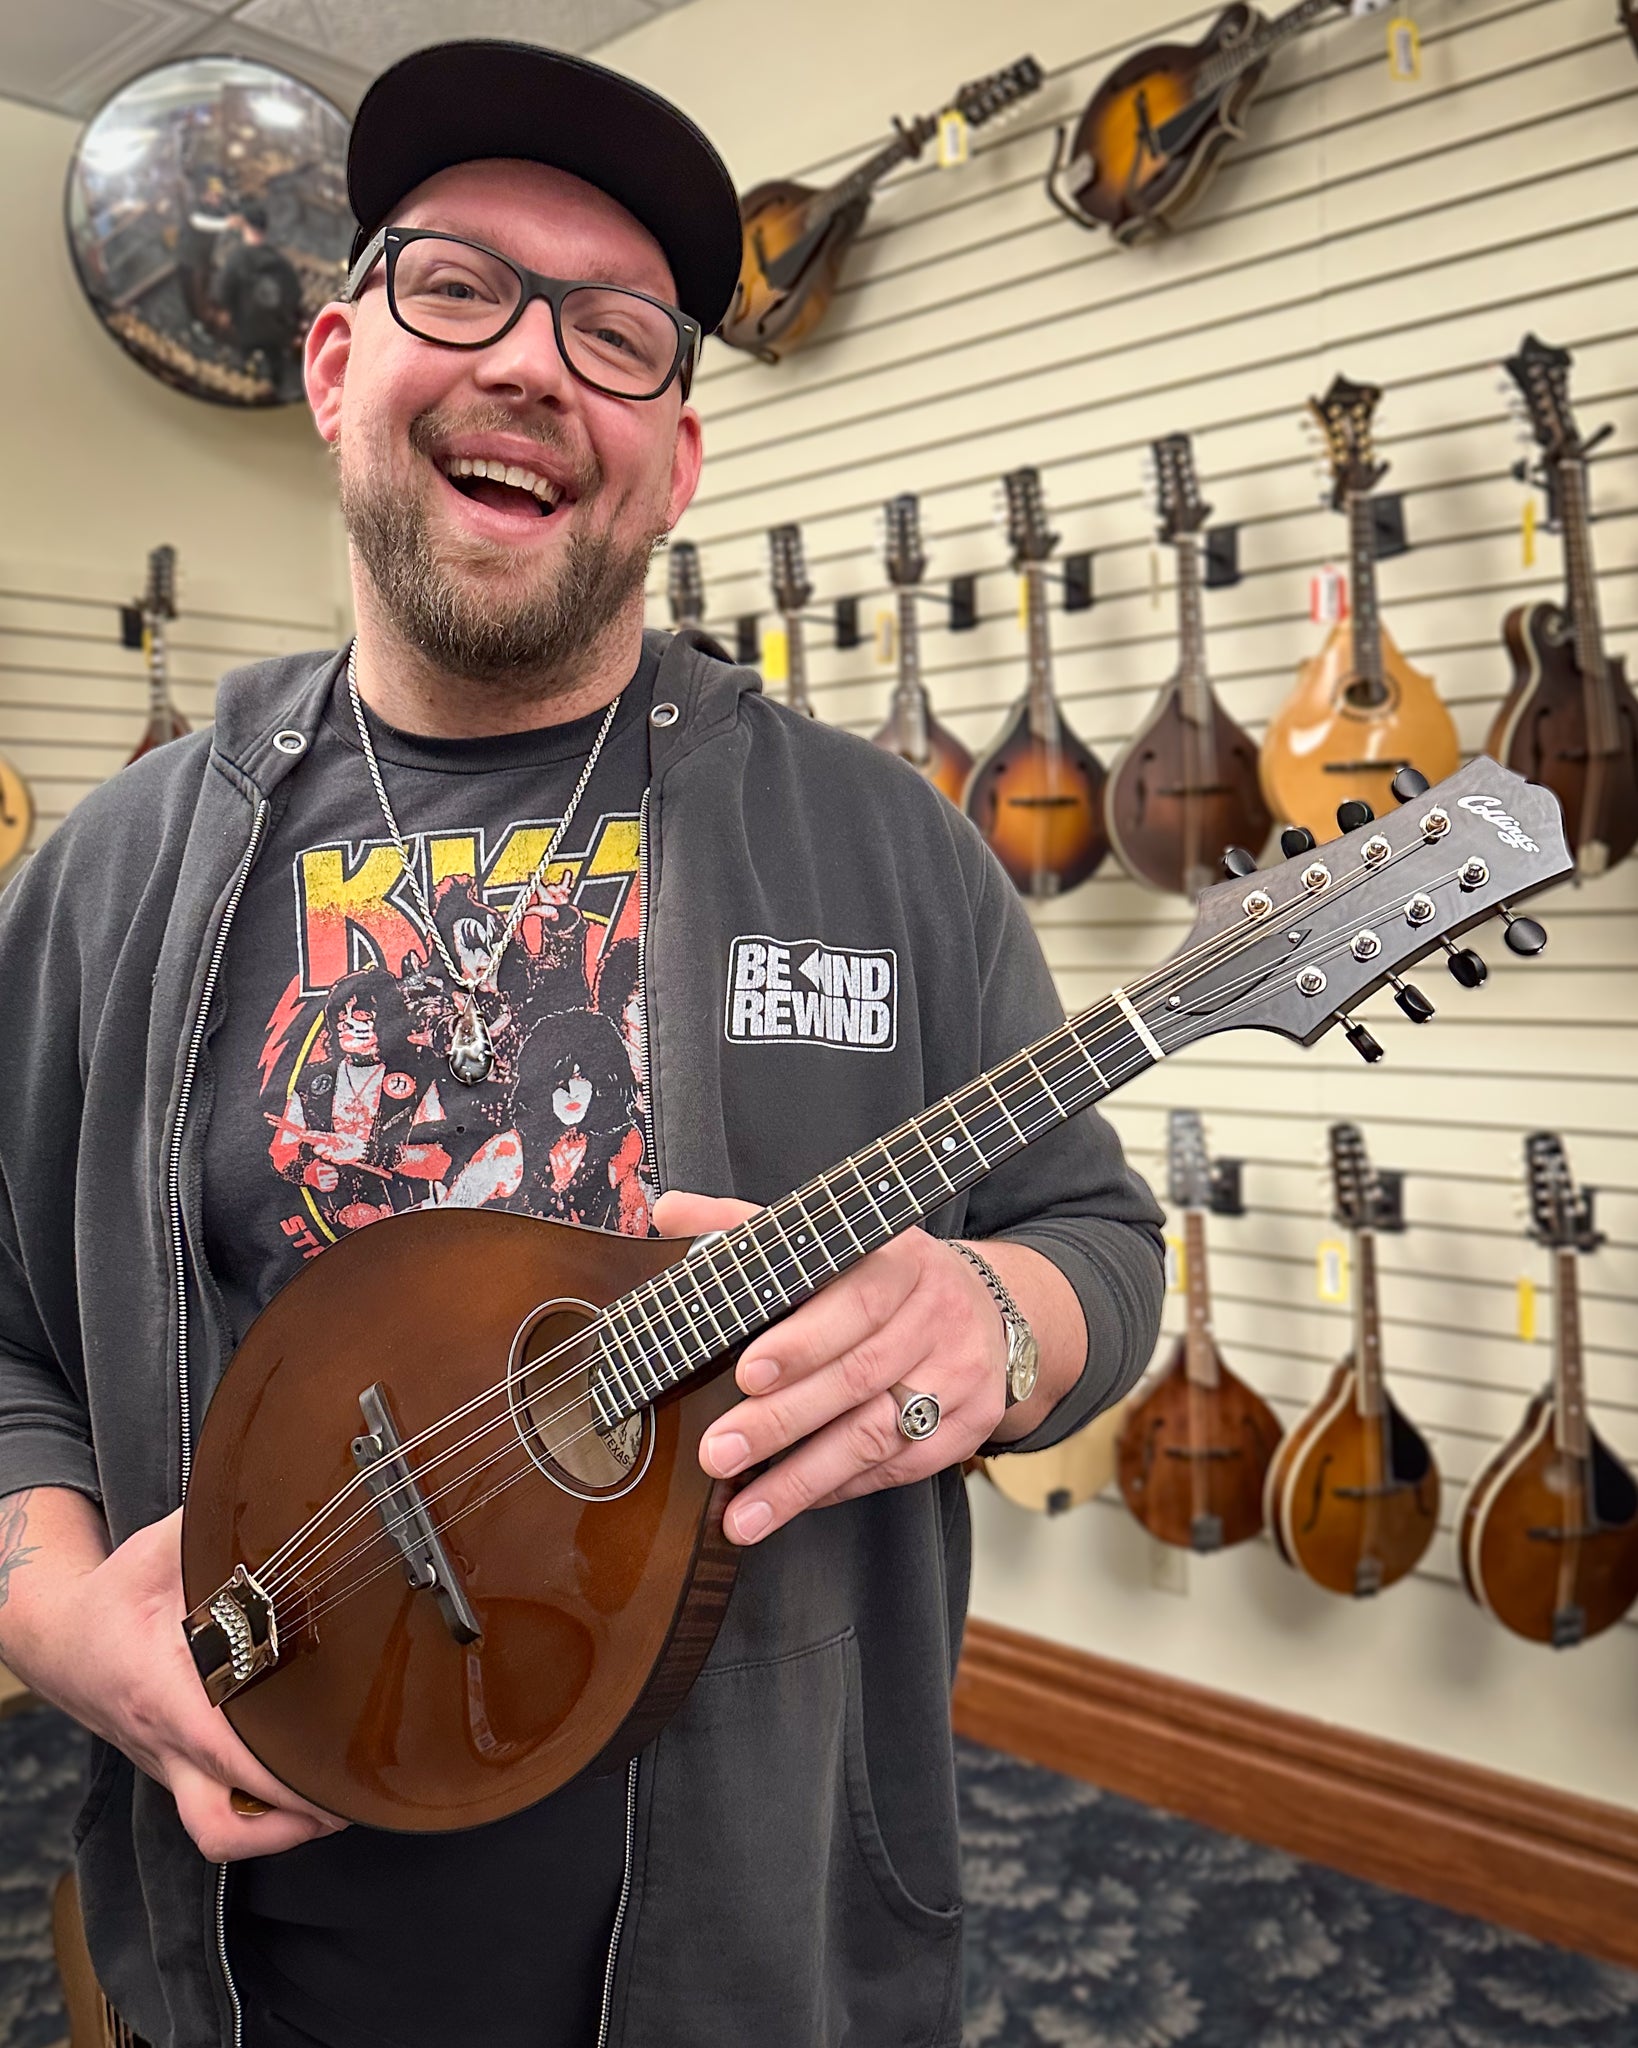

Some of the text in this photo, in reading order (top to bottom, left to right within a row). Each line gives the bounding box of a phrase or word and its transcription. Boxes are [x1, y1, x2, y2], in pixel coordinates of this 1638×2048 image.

[1457, 795, 1540, 853] Collings
[735, 943, 792, 991] BE
[732, 990, 891, 1044] REWIND
[603, 1432, 630, 1465] TEXAS
